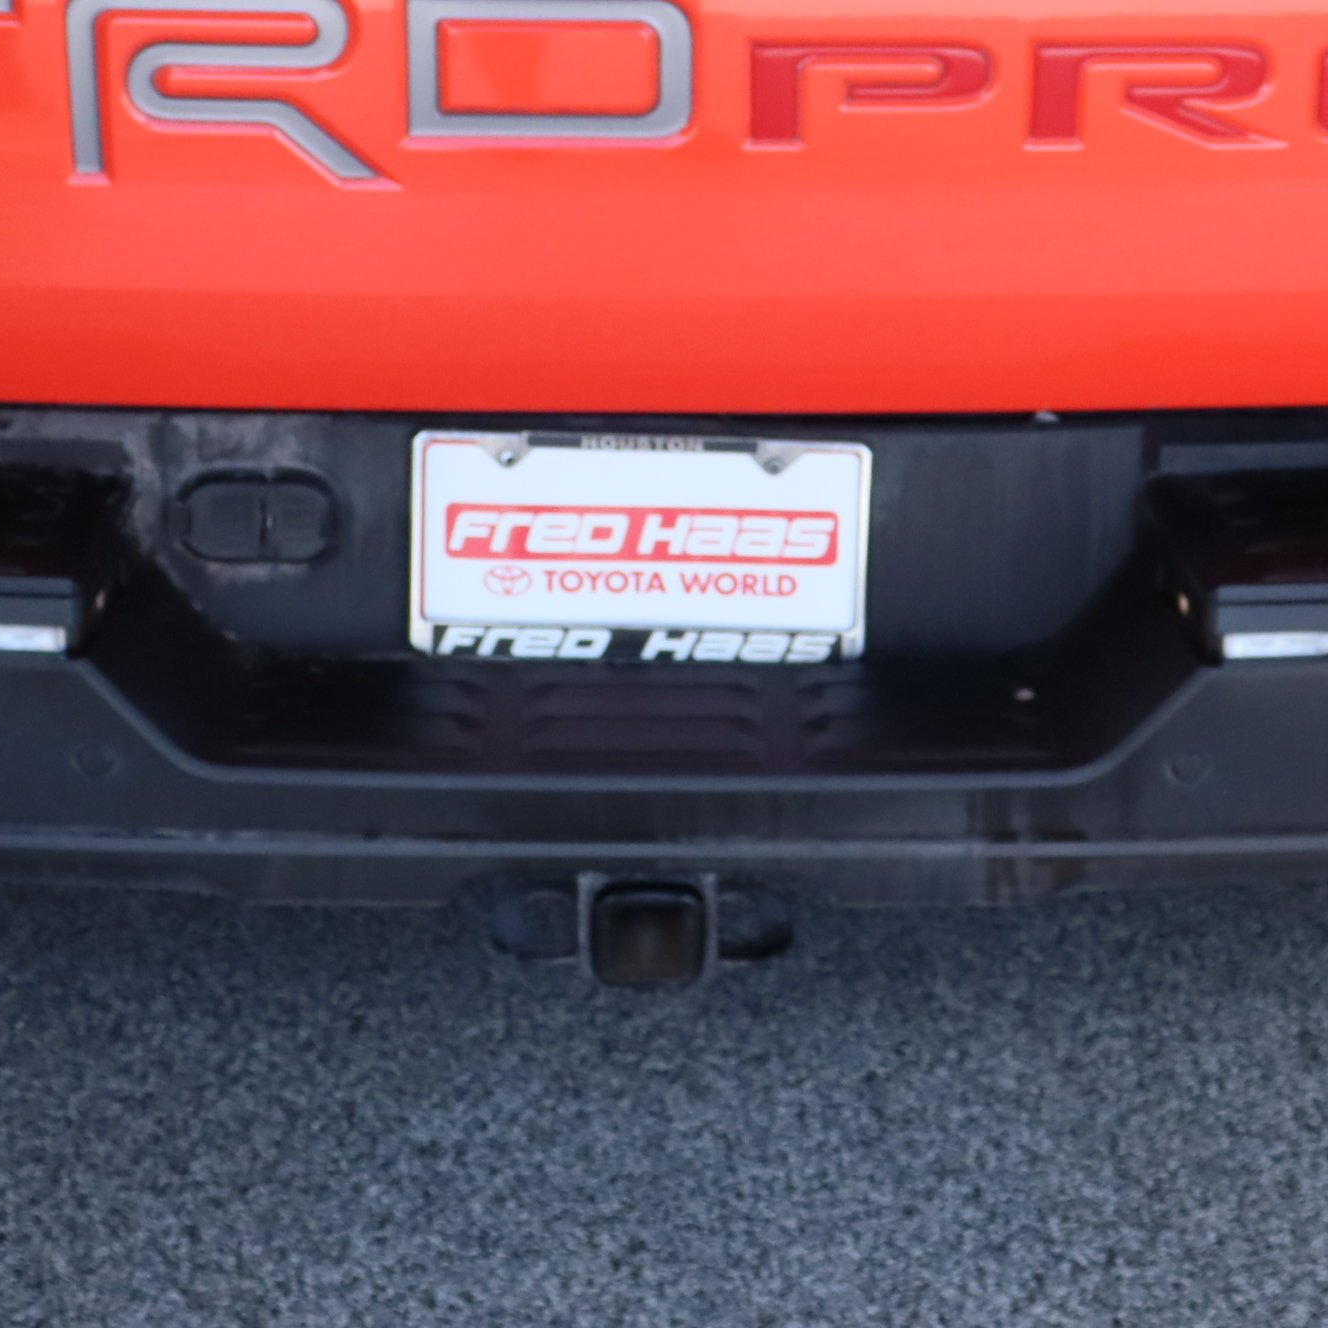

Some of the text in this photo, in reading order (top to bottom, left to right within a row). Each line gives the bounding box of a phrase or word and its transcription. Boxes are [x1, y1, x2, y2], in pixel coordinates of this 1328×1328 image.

[581, 435, 704, 452] HOUSTON
[544, 570, 797, 597] TOYOTA WORLD
